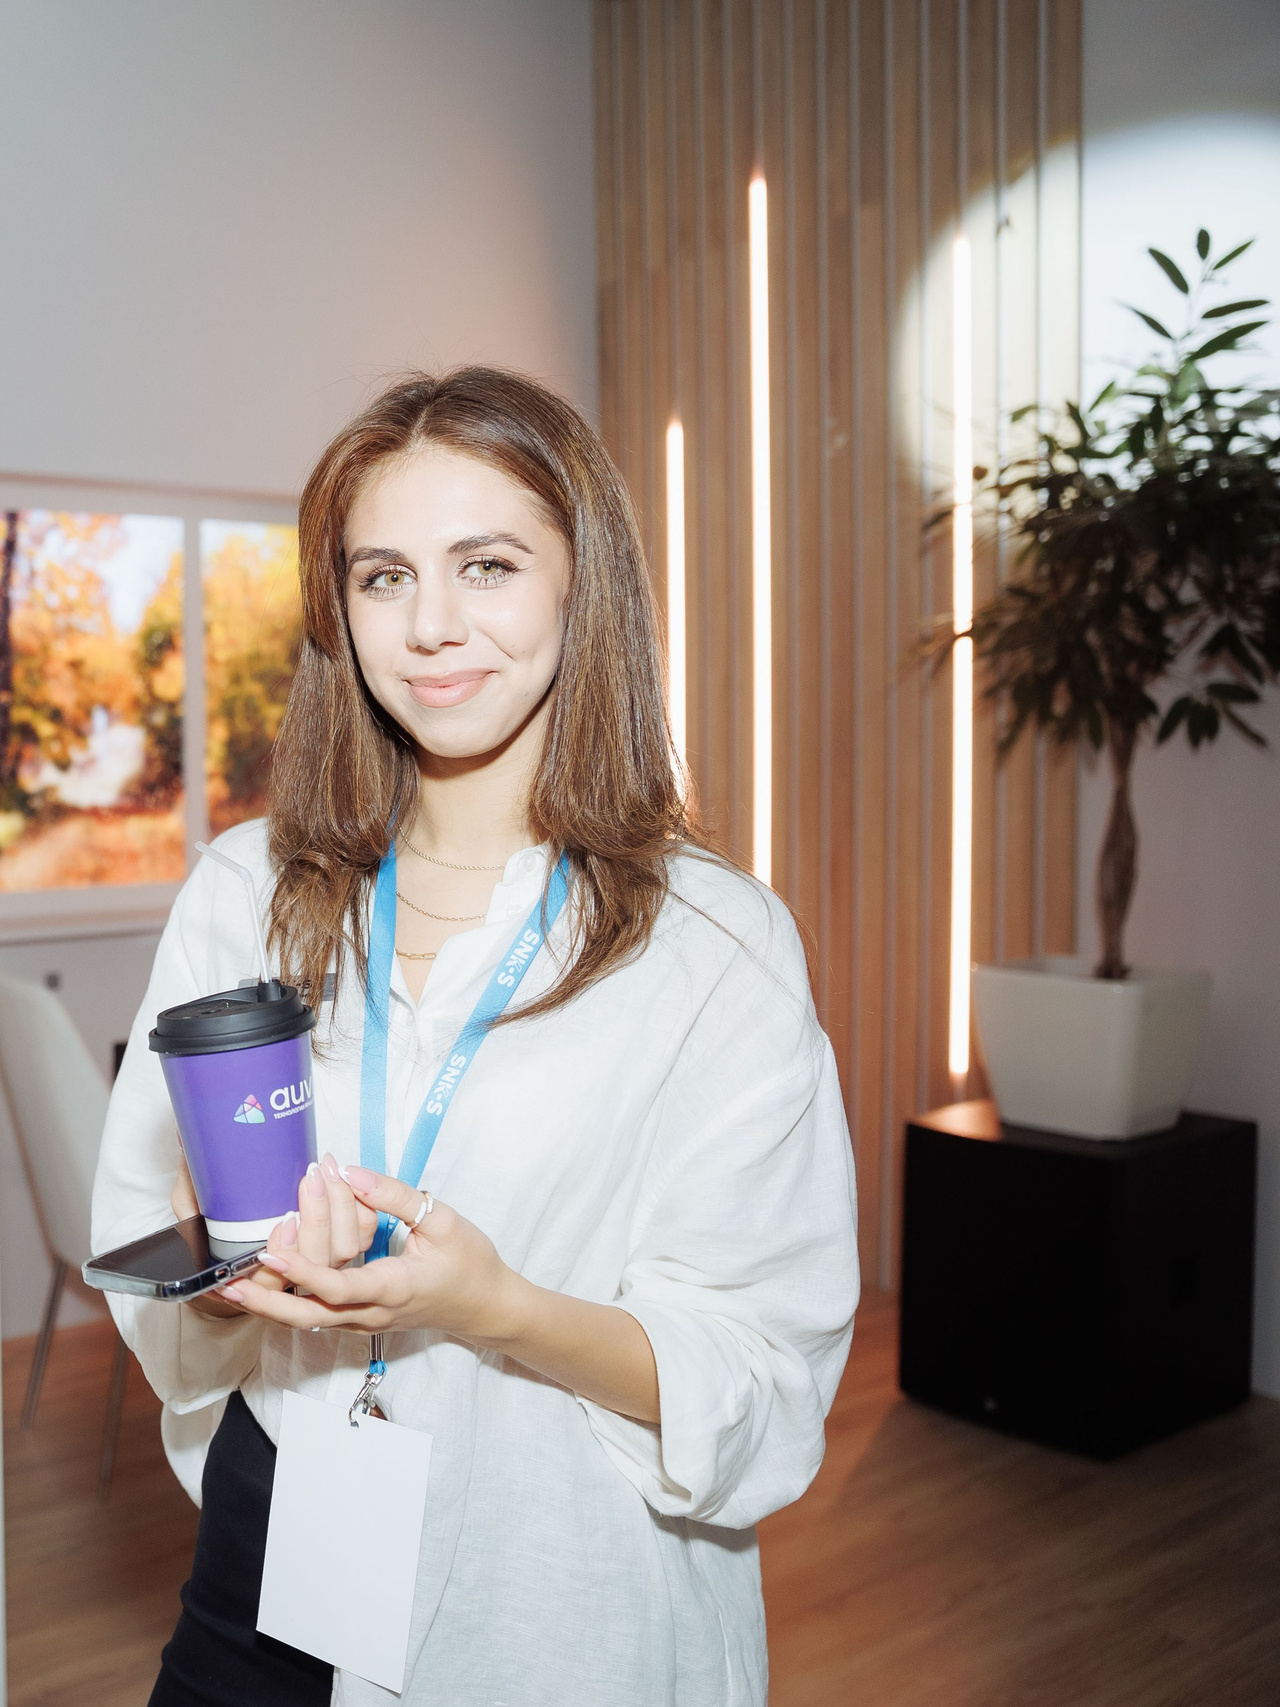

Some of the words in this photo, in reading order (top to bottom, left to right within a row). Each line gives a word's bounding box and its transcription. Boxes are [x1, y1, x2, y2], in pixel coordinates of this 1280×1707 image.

[497, 928, 540, 988] SNK-S
[270, 1076, 312, 1111] auv
[426, 1053, 467, 1116] SNK-S
